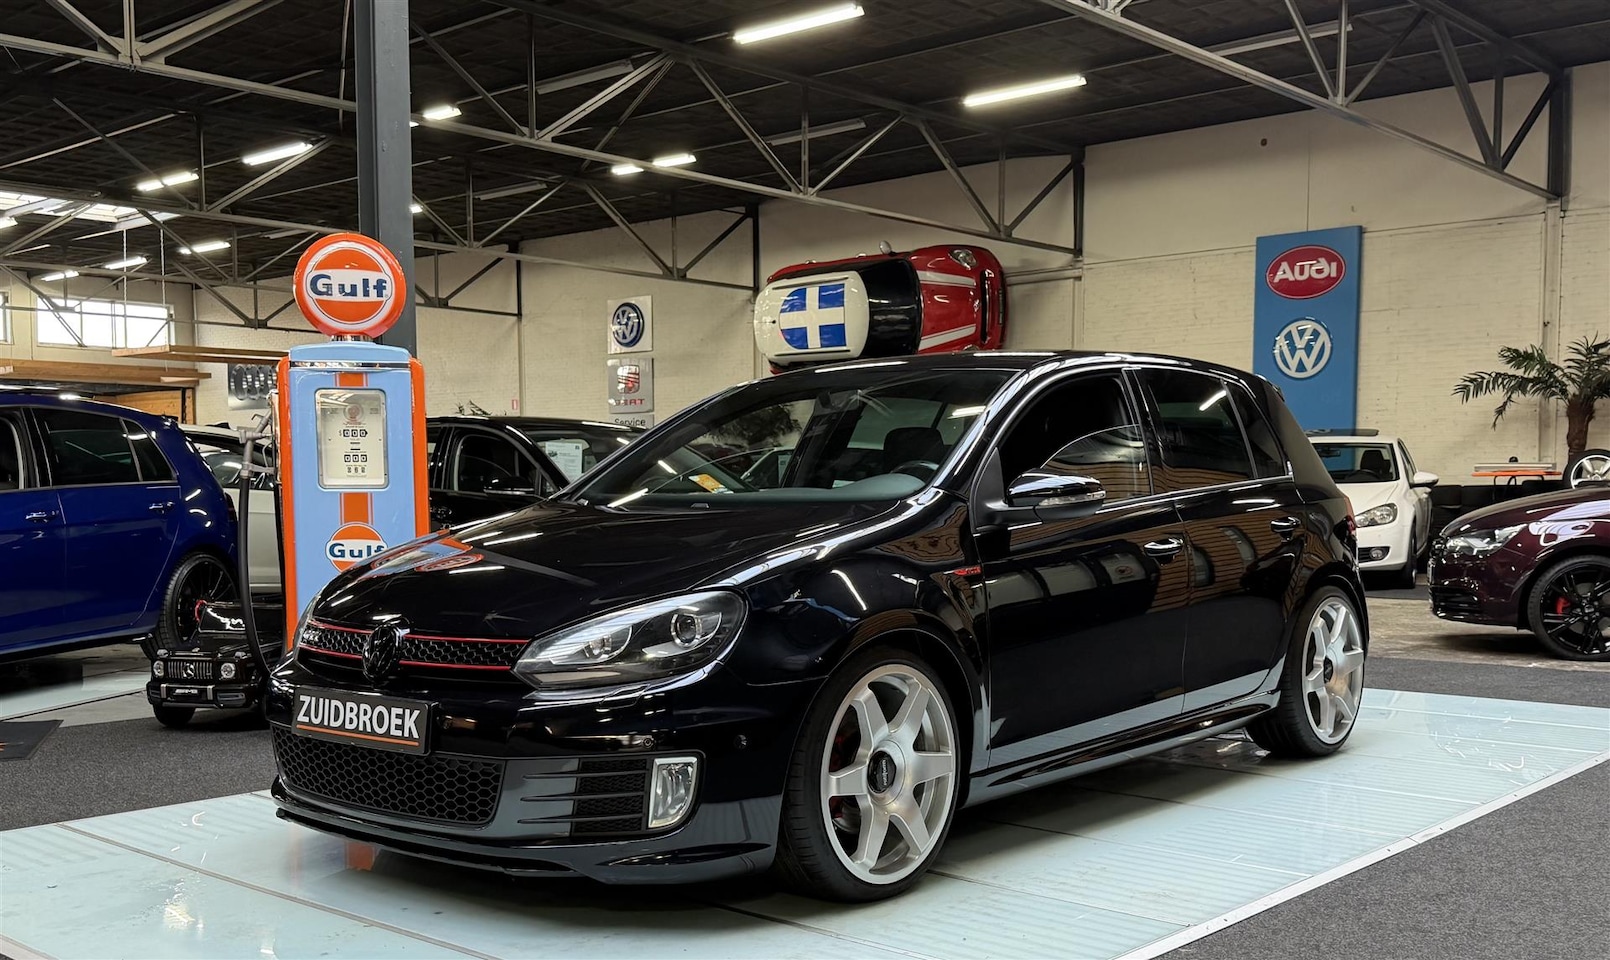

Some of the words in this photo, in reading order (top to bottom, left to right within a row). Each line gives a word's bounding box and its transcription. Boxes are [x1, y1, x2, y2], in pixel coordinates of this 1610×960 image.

[310, 273, 387, 298] Gulf
[614, 417, 646, 426] Service
[297, 694, 420, 739] ZUIDBROEK
